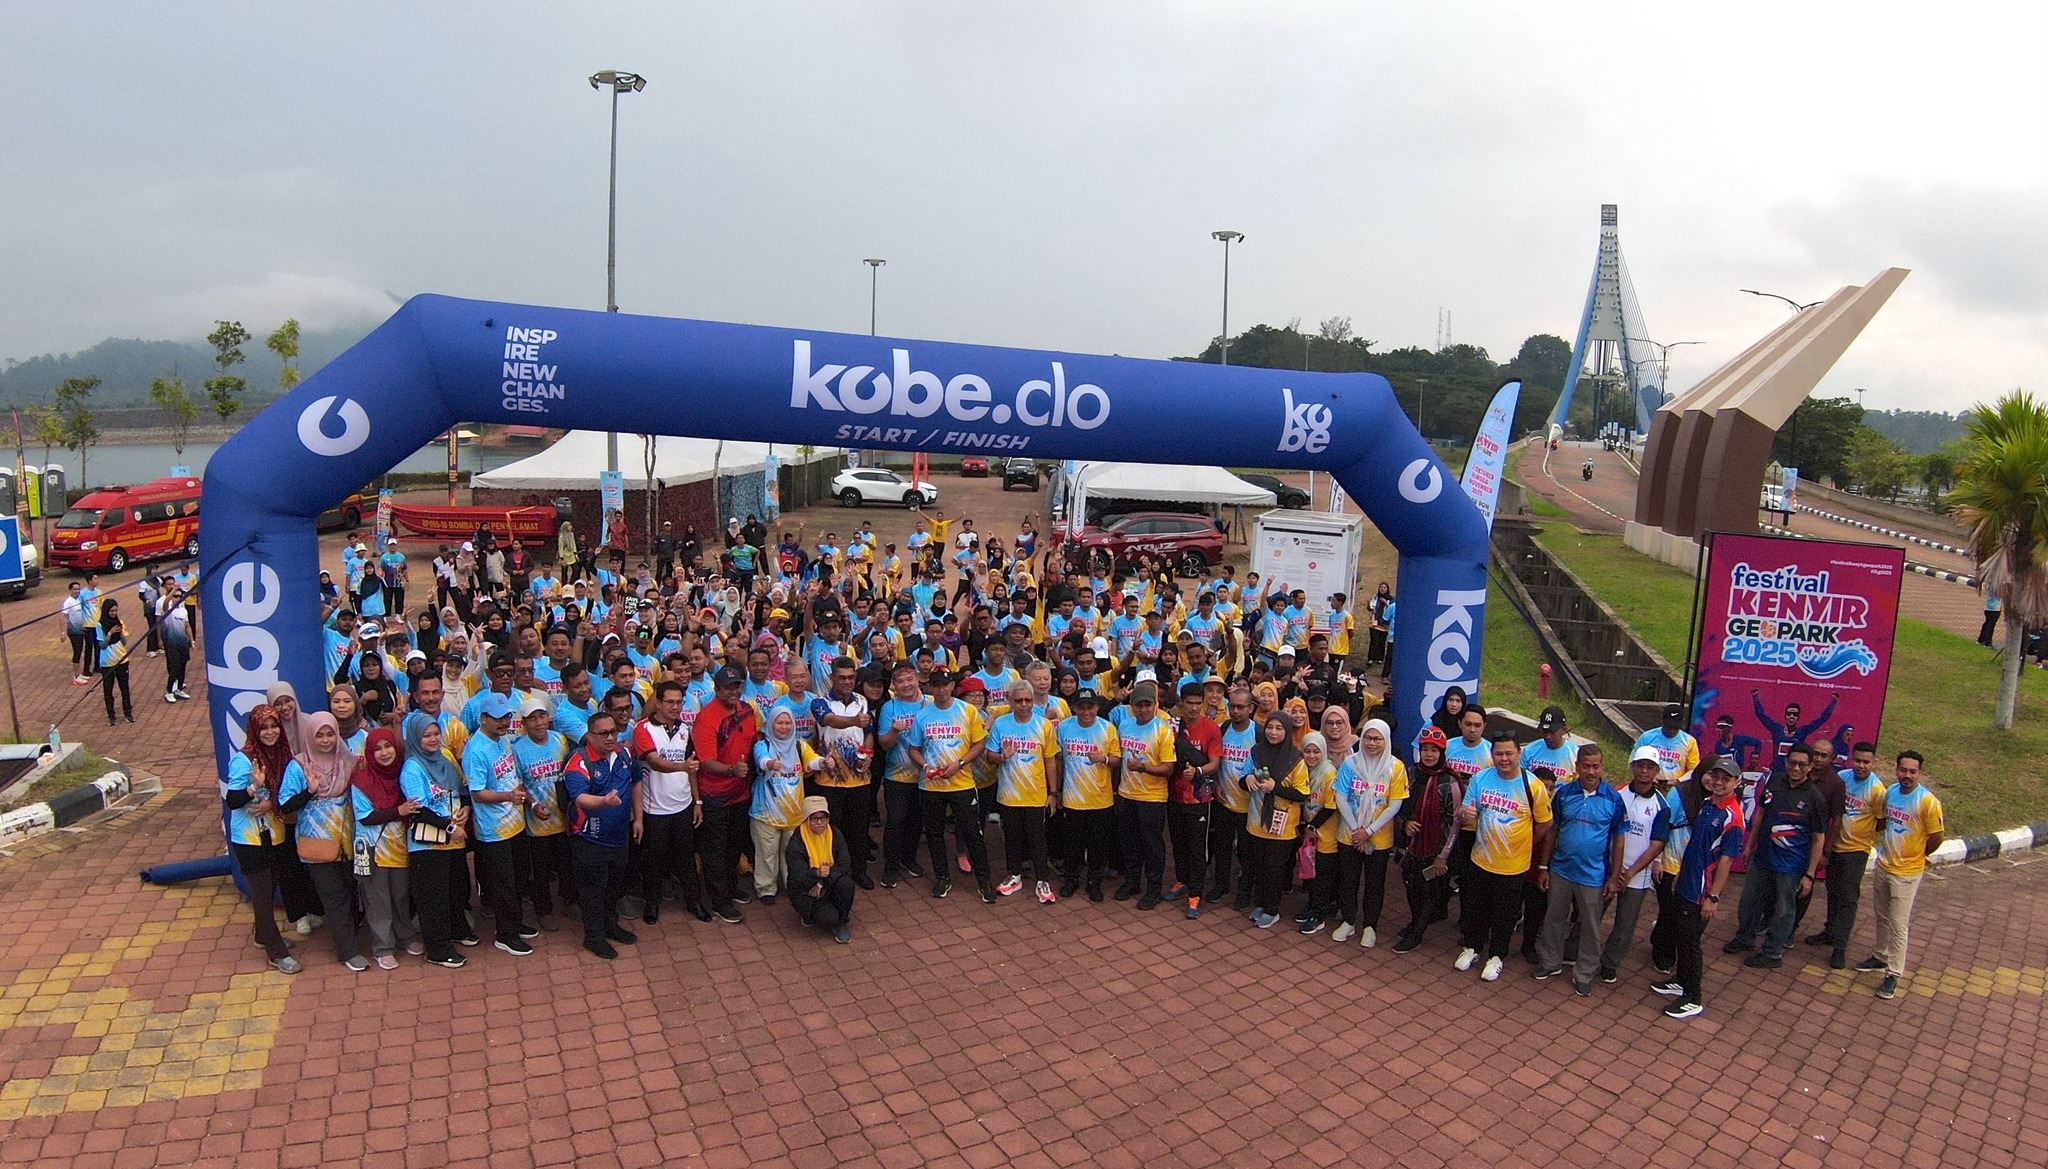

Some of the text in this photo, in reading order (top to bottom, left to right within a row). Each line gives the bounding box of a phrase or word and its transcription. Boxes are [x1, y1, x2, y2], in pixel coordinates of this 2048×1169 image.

[506, 326, 558, 345] INSP
[504, 343, 540, 361] IRE
[502, 362, 557, 381] NEW
[501, 380, 565, 400] CHAN
[501, 397, 549, 413] GES.
[834, 424, 917, 444] START
[941, 431, 1031, 451] FINISH
[448, 521, 474, 530] BOMBA
[490, 522, 539, 531] PENYELAMAT
[1123, 541, 1178, 553] ARUZ
[1733, 564, 1828, 594] festival
[1729, 588, 1869, 627] KENYIR
[1723, 637, 1797, 665] 2025
[925, 726, 962, 736] KENYIR
[1065, 737, 1089, 745] festival
[1658, 749, 1682, 760] NYIR
[529, 757, 554, 769] festival
[1446, 762, 1482, 774] KENYIR
[1531, 764, 1567, 777] KYIR
[1481, 787, 1509, 798] festival
[1480, 794, 1520, 812] KENYIR
